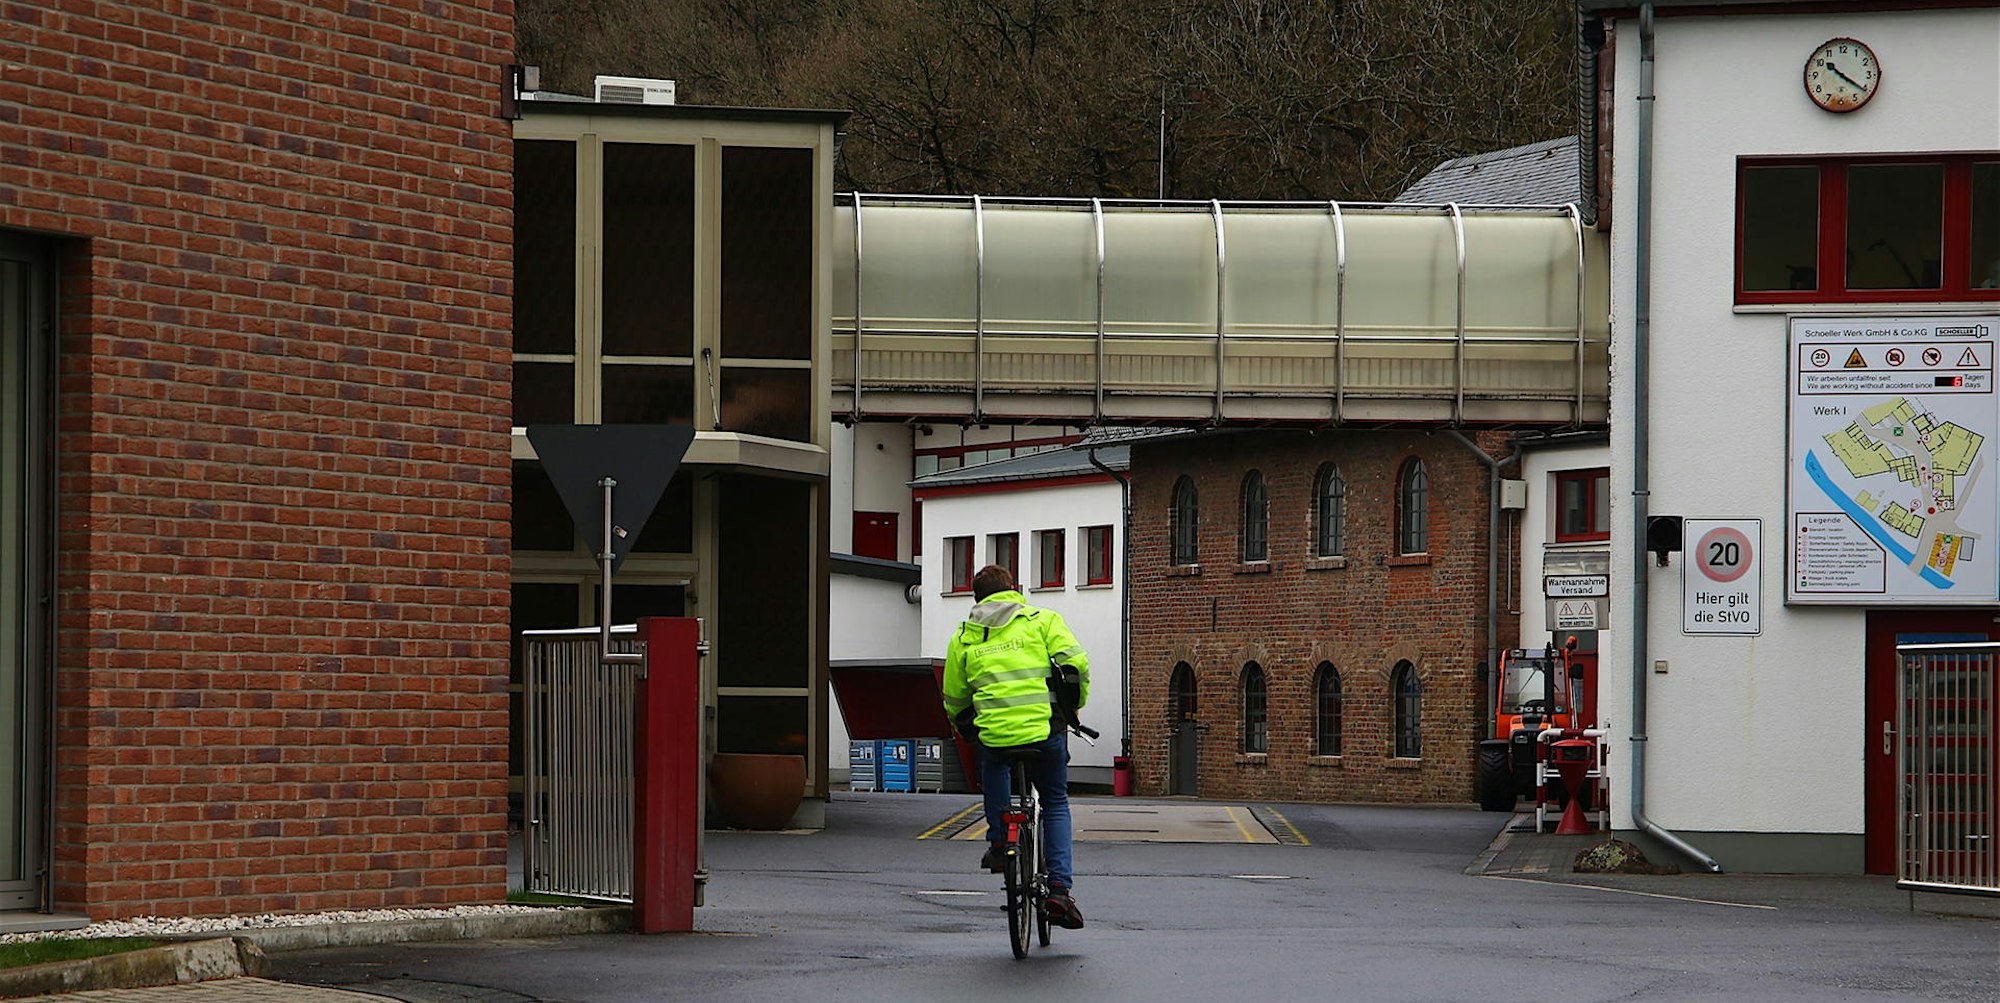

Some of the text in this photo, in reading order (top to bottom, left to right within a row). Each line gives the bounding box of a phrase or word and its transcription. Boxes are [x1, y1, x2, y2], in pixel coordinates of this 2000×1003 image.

[1826, 49, 1832, 57] 11
[1839, 46, 1848, 54] 12
[1854, 49, 1858, 57] 1
[1816, 58, 1824, 67] 10
[1862, 57, 1868, 66] 2
[1812, 71, 1819, 79] 9
[1866, 71, 1872, 79] 3
[1816, 84, 1822, 93] 8
[1826, 93, 1832, 101] 7
[1852, 93, 1858, 101] 5
[1805, 329, 1841, 337] Schoeller
[1843, 329, 1863, 337] Werk
[1964, 373, 1985, 382] Tagen
[1814, 406, 1840, 416] Werk
[1708, 541, 1740, 567] 20
[1548, 577, 1606, 587] Warenannahme
[1560, 586, 1594, 595] Versand
[1696, 592, 1750, 608] Hier gilt
[1694, 610, 1751, 623] die StVO
